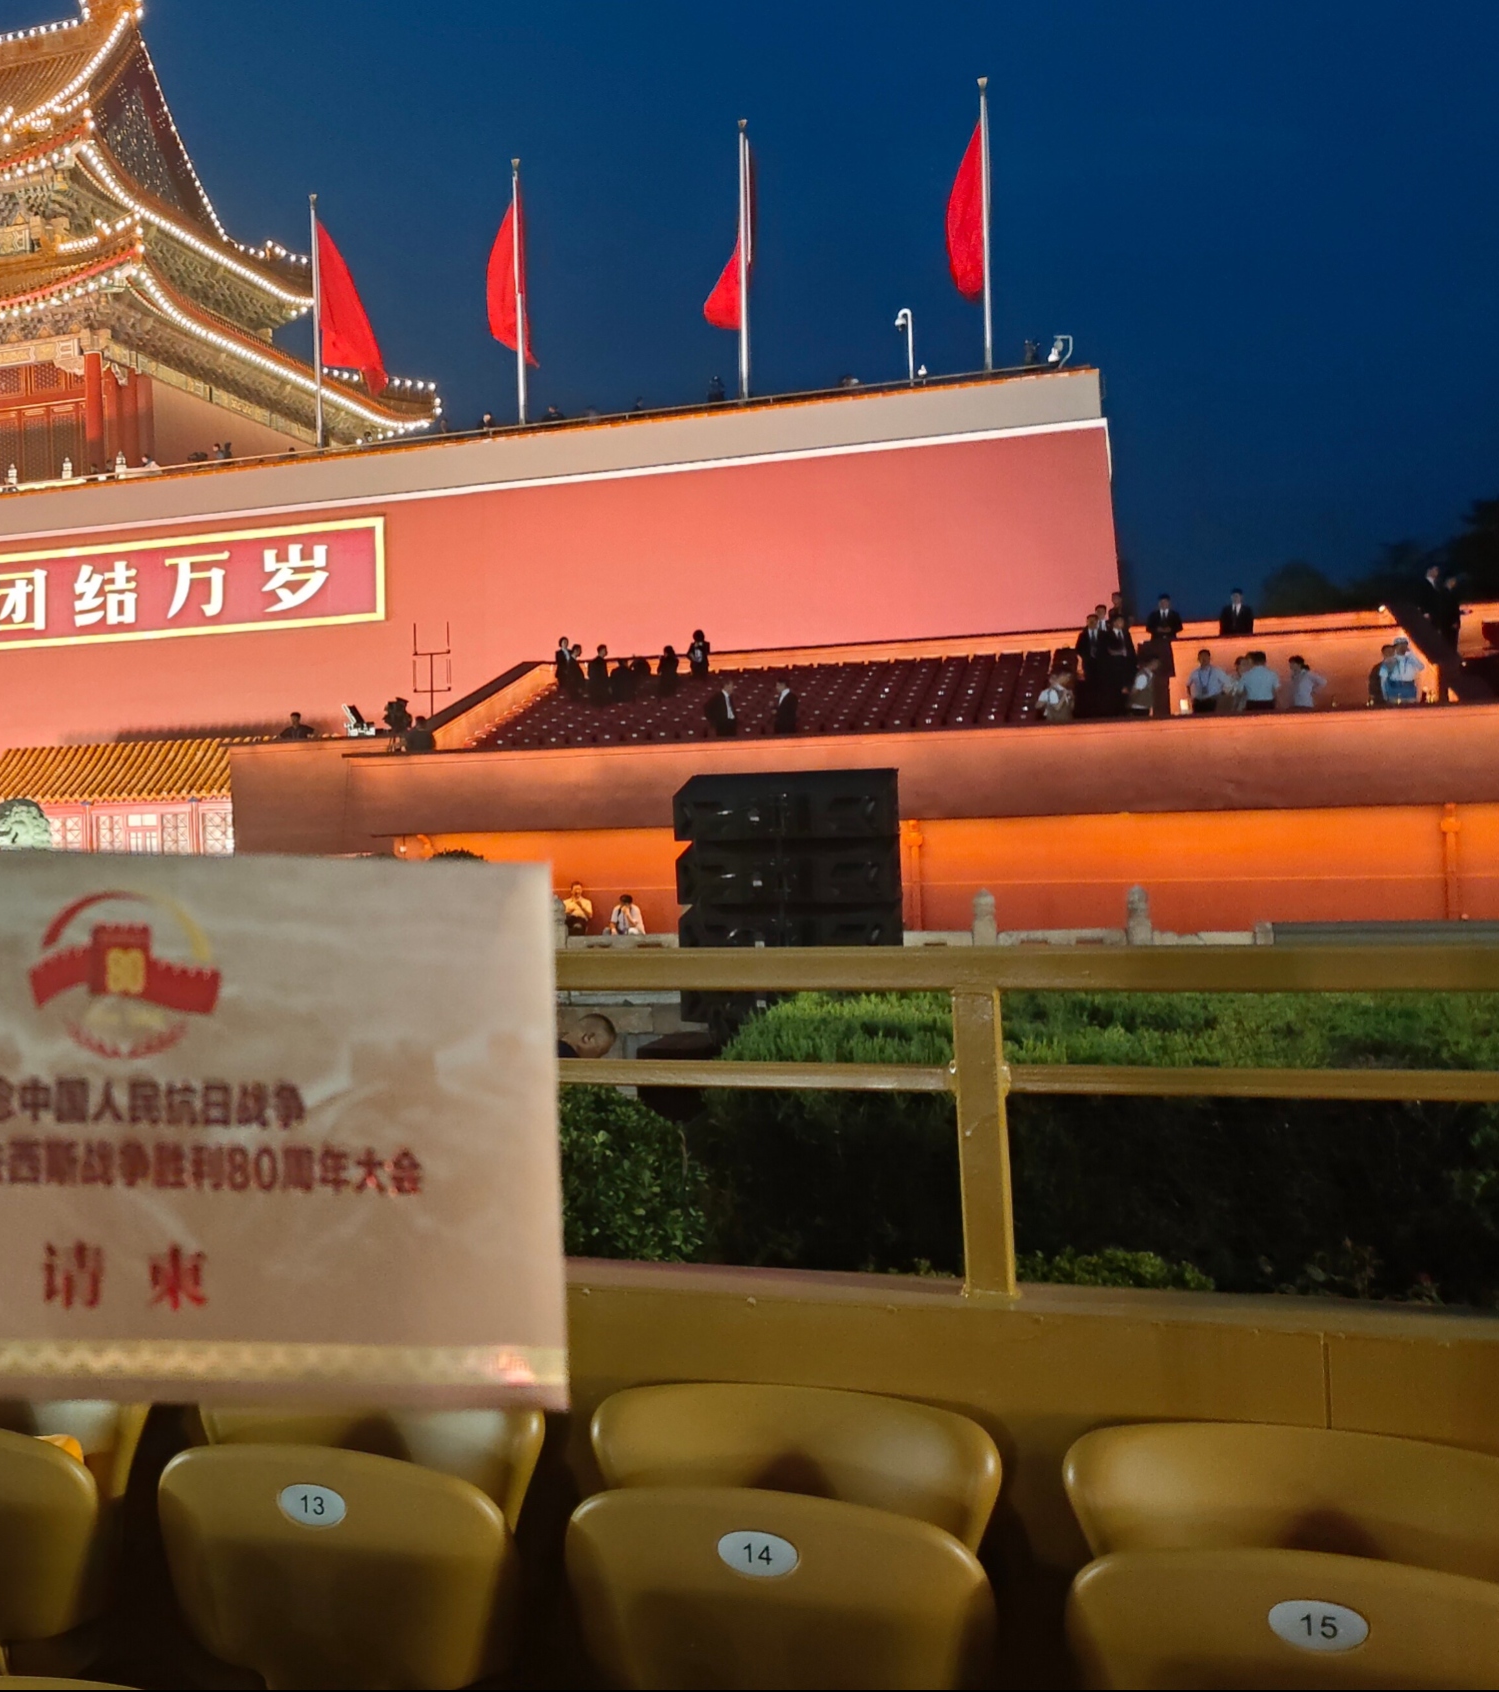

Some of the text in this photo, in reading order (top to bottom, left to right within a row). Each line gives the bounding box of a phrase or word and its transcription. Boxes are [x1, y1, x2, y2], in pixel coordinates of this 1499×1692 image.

[300, 1494, 325, 1516] 13
[742, 1542, 773, 1566] 14
[1299, 1611, 1338, 1640] 15
